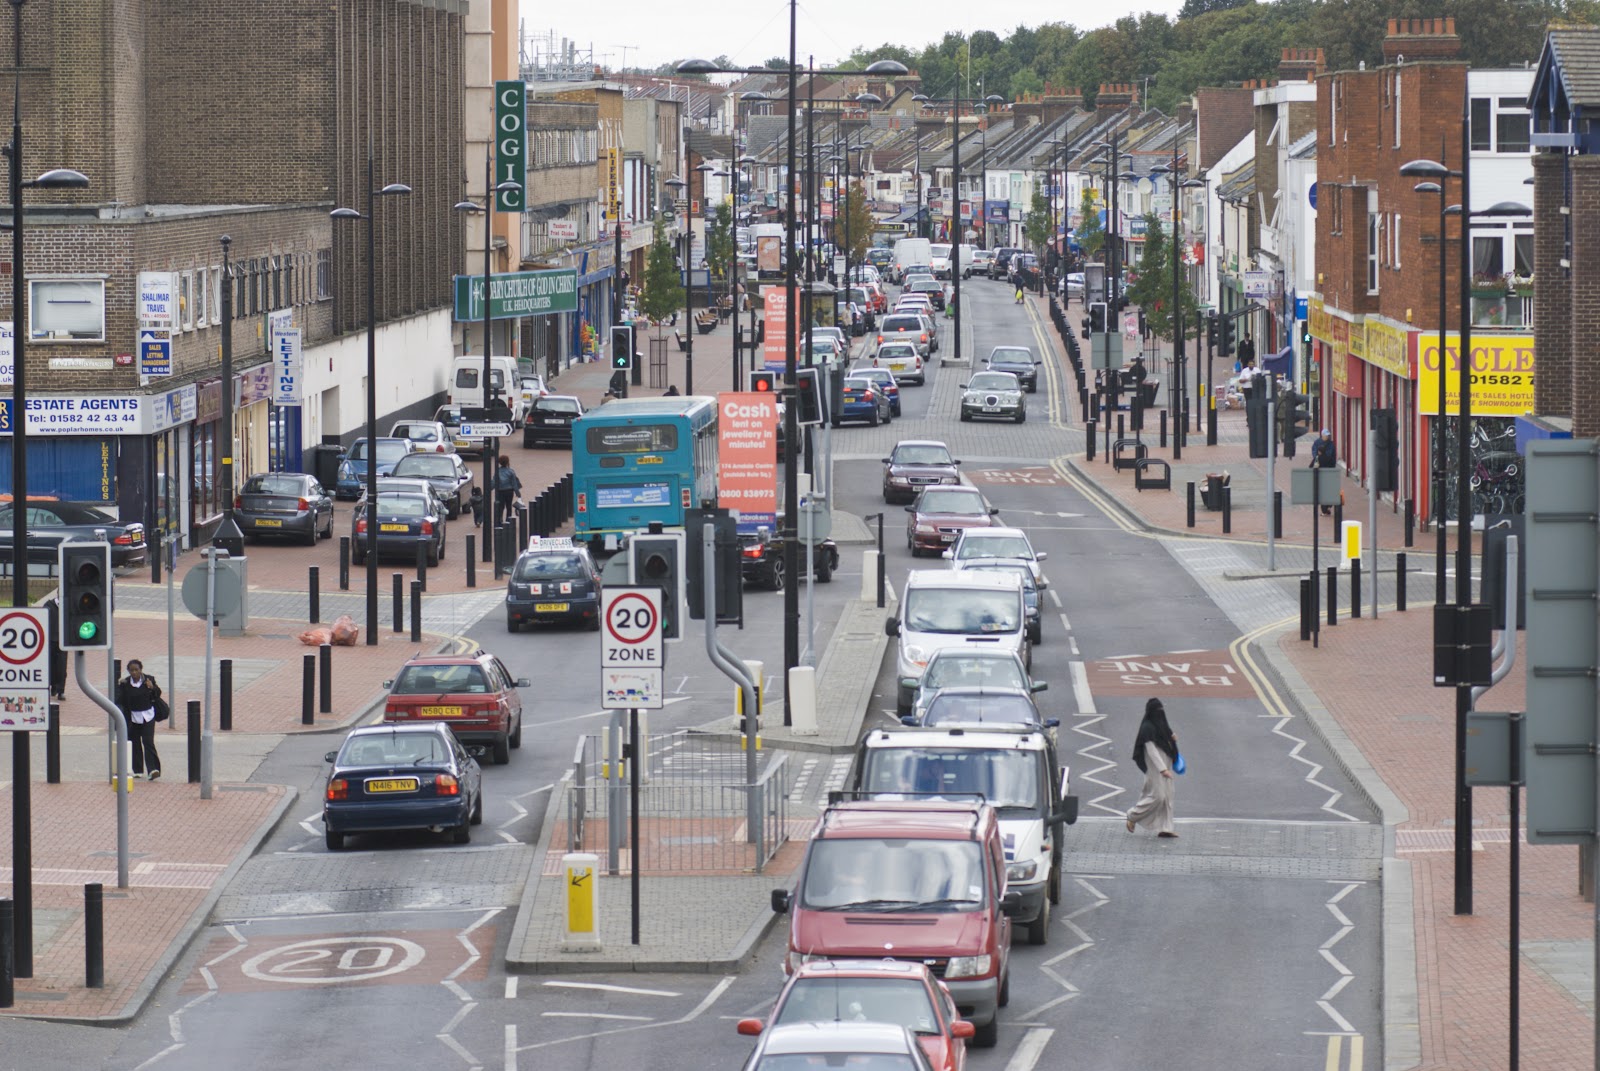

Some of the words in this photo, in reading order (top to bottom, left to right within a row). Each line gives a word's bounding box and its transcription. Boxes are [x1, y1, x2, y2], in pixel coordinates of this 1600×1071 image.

[500, 89, 520, 207] COGIC
[609, 152, 617, 215] LIFESTYLE
[504, 278, 528, 299] CHURCH
[528, 277, 536, 297] OF
[537, 276, 548, 296] GOD
[548, 277, 556, 294] IN
[556, 274, 575, 294] CHRIST
[141, 292, 170, 302] SHALIMAR
[146, 303, 166, 313] TRAVEL
[502, 301, 513, 312] U.K.
[514, 296, 551, 312] HEADQUARTERS
[280, 337, 294, 392] LETTING
[1470, 374, 1522, 385] 01582
[25, 399, 75, 410] ESTATE
[80, 398, 138, 410] AGENTS
[724, 401, 771, 418] Cash
[28, 414, 46, 423] Tel:
[49, 414, 83, 422] 01582
[86, 414, 100, 422] 42
[104, 414, 118, 422] 43
[121, 414, 135, 422] 44
[732, 419, 749, 428] lent
[751, 420, 763, 428] on
[39, 426, 124, 434] www.poplarhomes.co.uk
[722, 430, 762, 441] jewellery
[764, 430, 773, 438] in
[728, 440, 766, 449] minutes!
[101, 441, 109, 500] LETTINGS
[720, 489, 742, 498] 0800
[540, 538, 572, 546] DRIVECLASS
[616, 608, 651, 629] 20
[2, 628, 38, 649] 20
[608, 648, 656, 661] ZONE
[1095, 661, 1237, 674] LANE
[1120, 674, 1233, 687] BUS
[445, 707, 461, 715] CET
[395, 780, 412, 789] TNV
[270, 947, 394, 974] 20
